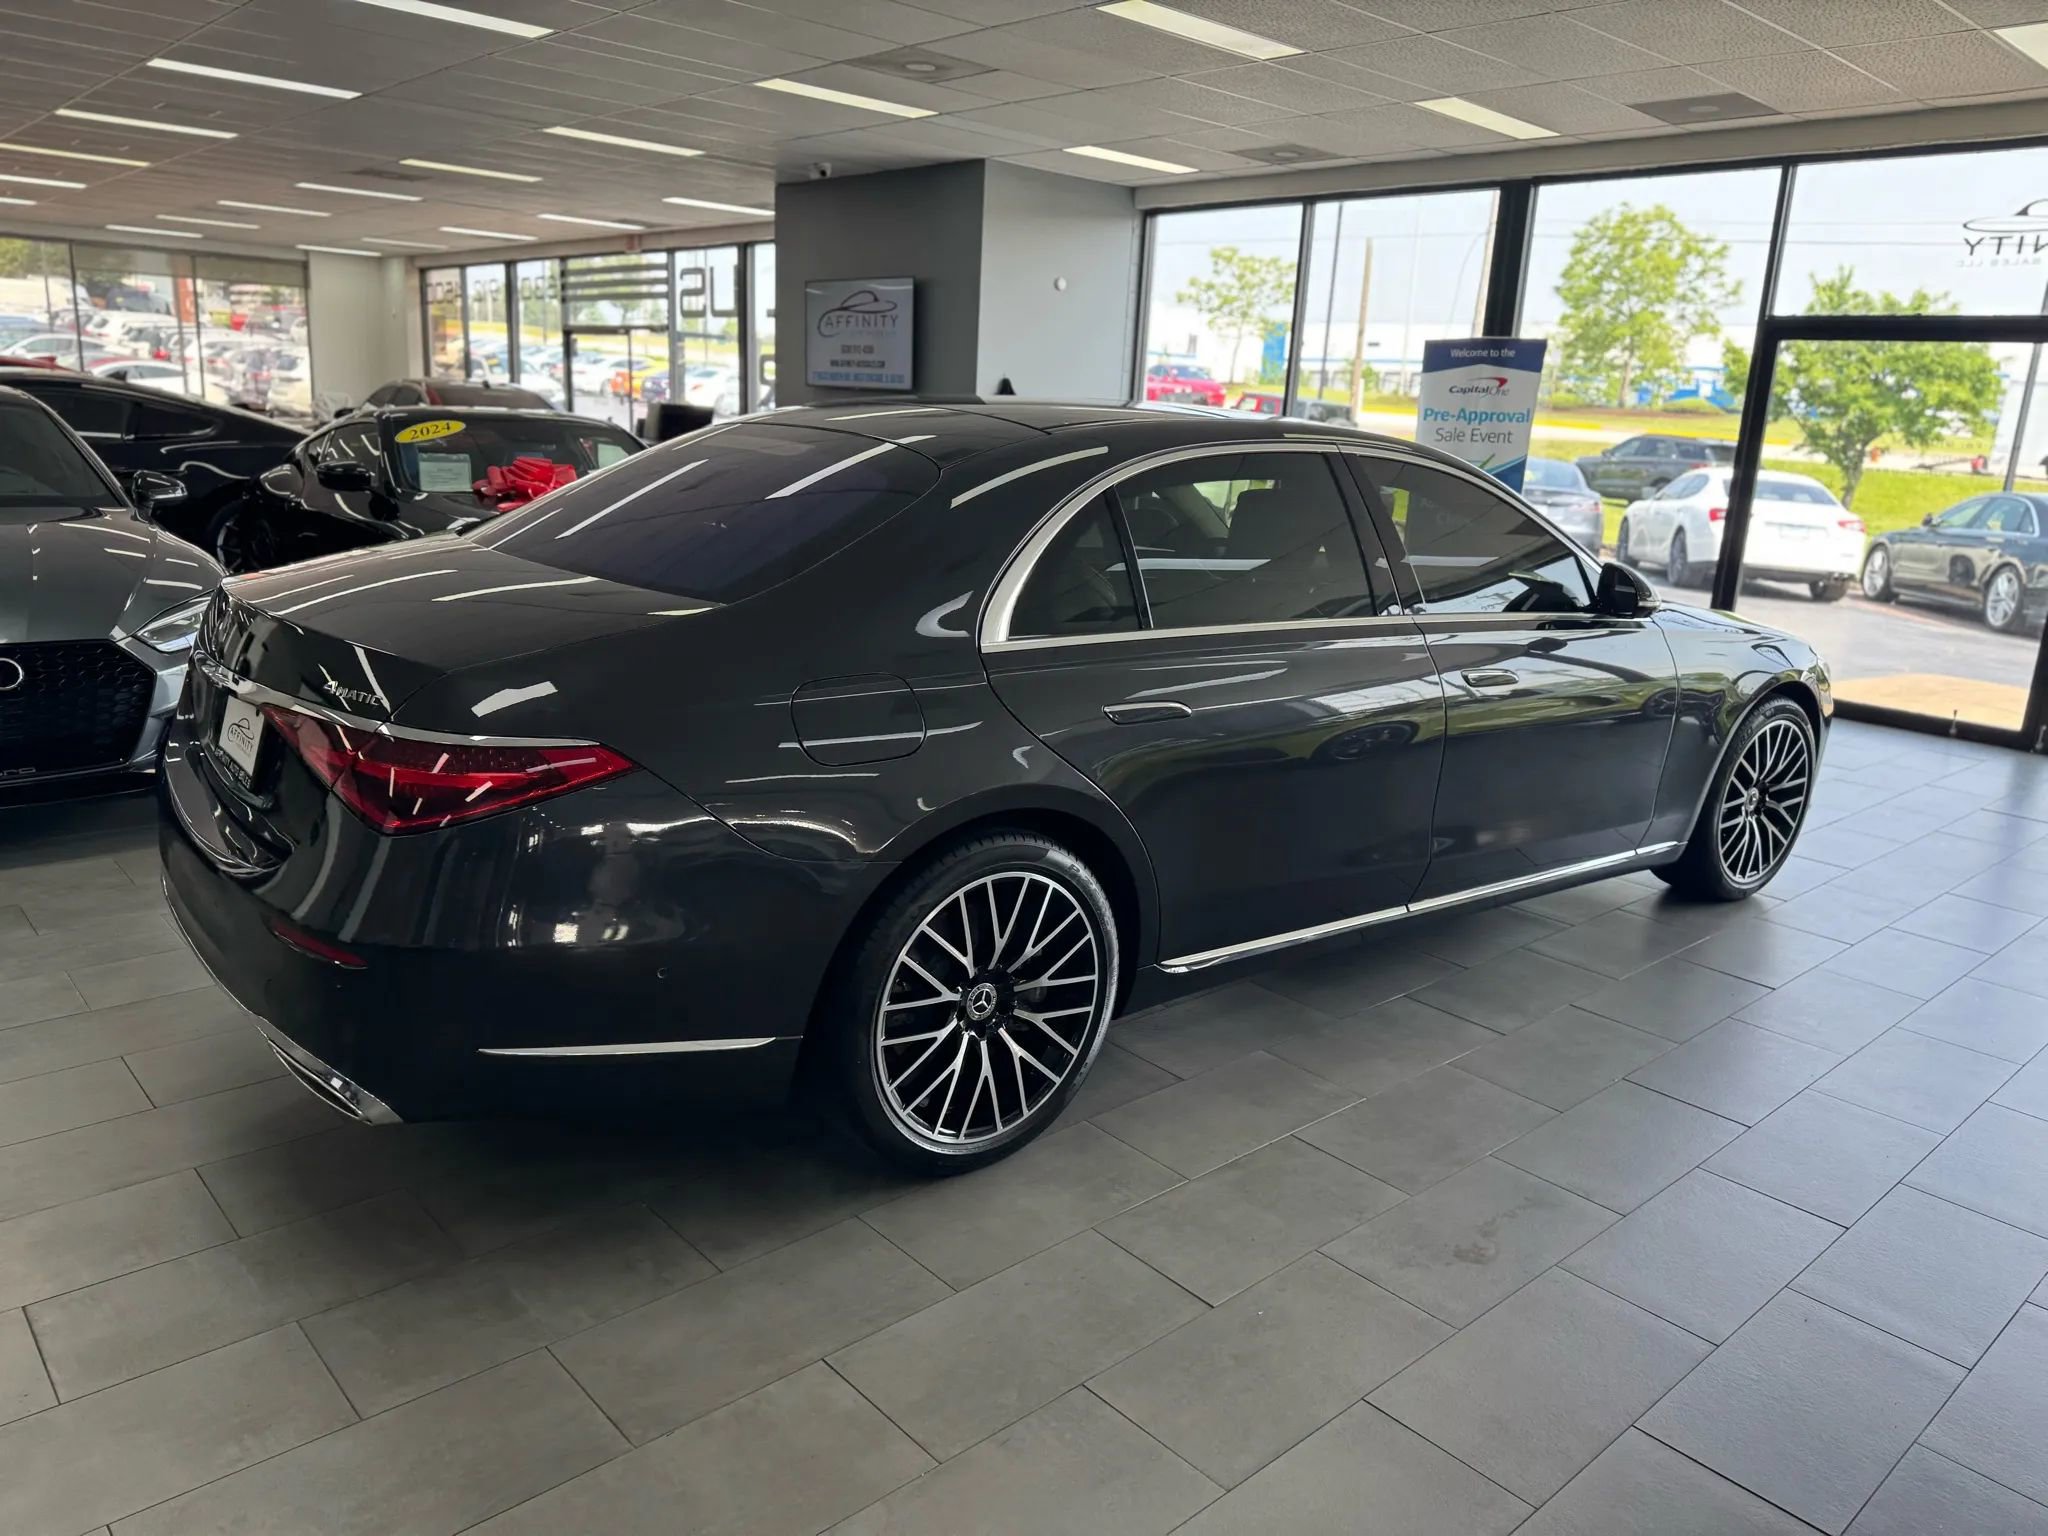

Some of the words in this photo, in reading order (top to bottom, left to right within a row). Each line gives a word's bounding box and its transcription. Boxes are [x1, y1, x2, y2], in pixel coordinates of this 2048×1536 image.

[825, 314, 899, 329] AFFINITY
[1450, 348, 1489, 358] Welcome
[1489, 349, 1500, 358] to
[1500, 349, 1516, 358] the
[1423, 407, 1531, 426] Pre-Approval
[409, 422, 452, 440] 2024
[1434, 427, 1466, 443] Sale
[1470, 428, 1514, 444] Event
[323, 680, 384, 706] 4MATIC
